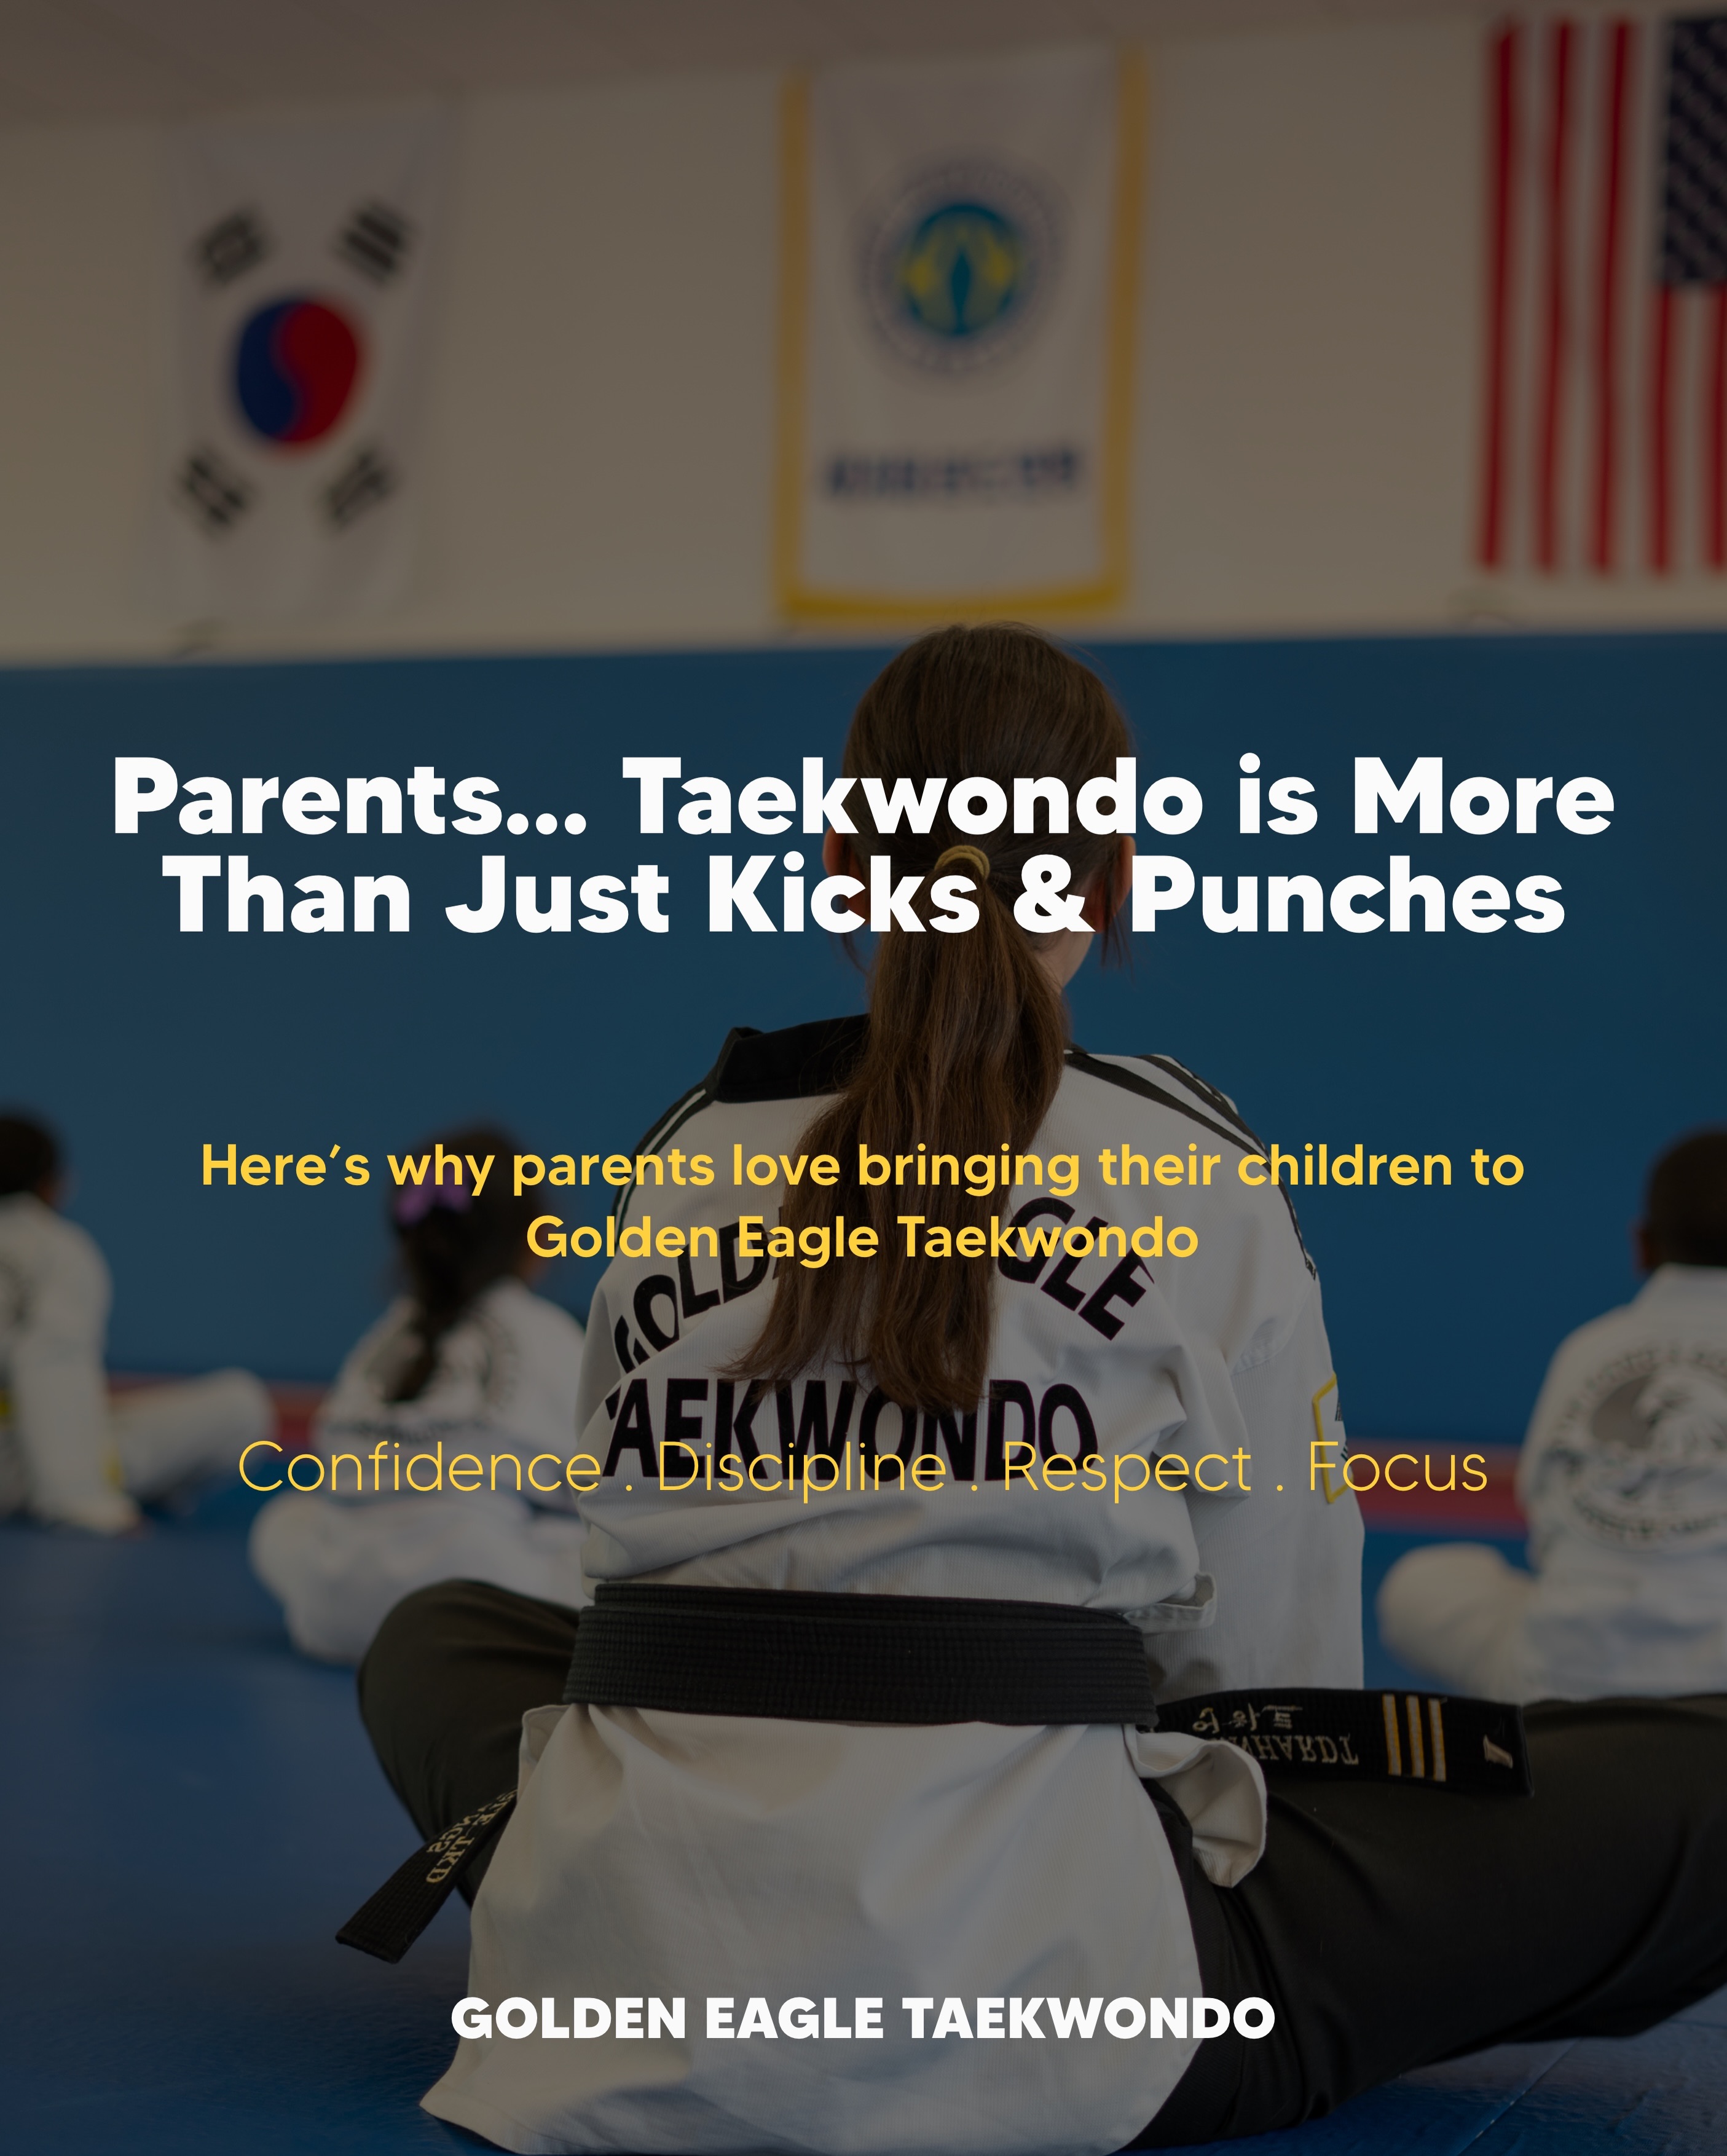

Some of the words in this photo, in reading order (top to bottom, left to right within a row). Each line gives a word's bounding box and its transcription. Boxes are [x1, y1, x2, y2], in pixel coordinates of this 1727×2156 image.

[614, 1206, 787, 1373] GOLD
[998, 1197, 1154, 1340] GLE
[602, 1377, 1098, 1482] AEKWONDO
